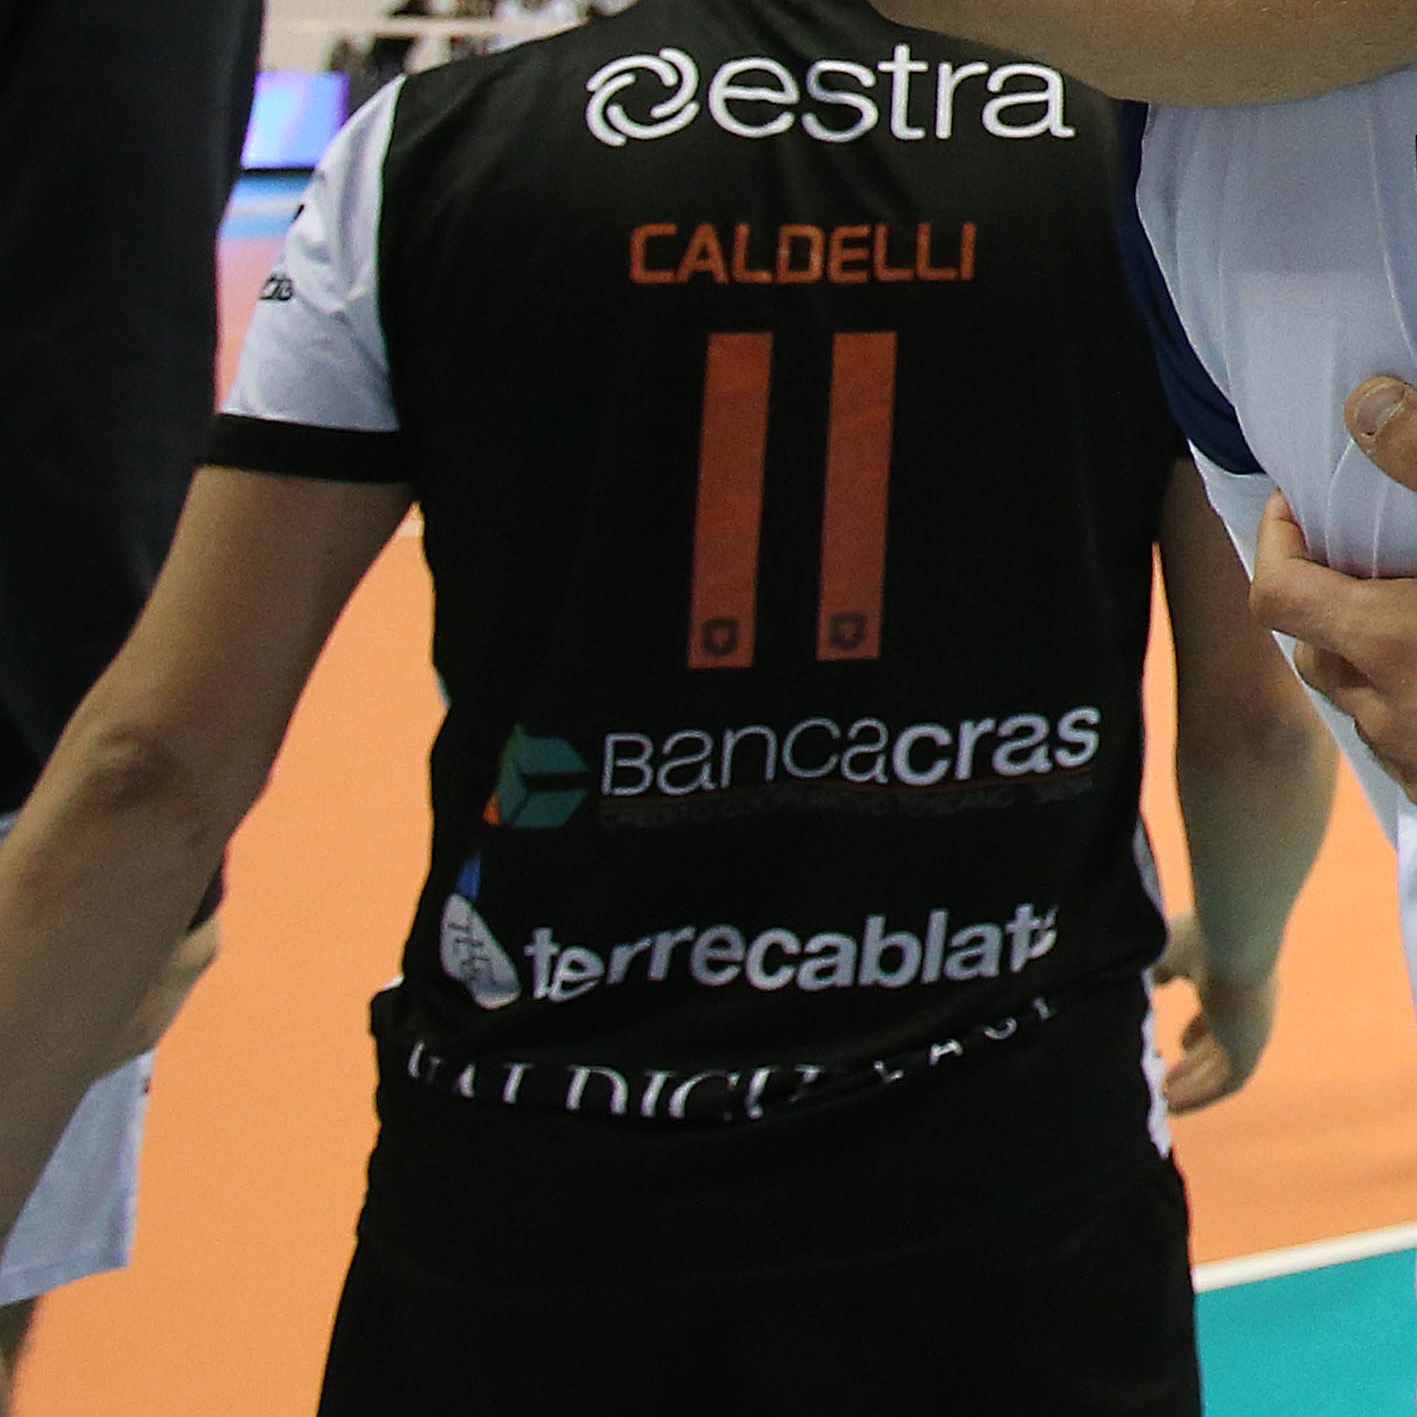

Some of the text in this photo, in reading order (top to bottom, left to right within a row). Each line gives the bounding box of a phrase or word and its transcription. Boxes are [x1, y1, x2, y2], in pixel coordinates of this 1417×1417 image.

[708, 43, 1076, 143] estra
[629, 222, 977, 284] CALDELLI
[685, 330, 899, 670] 11
[601, 705, 1102, 797] Bancacras
